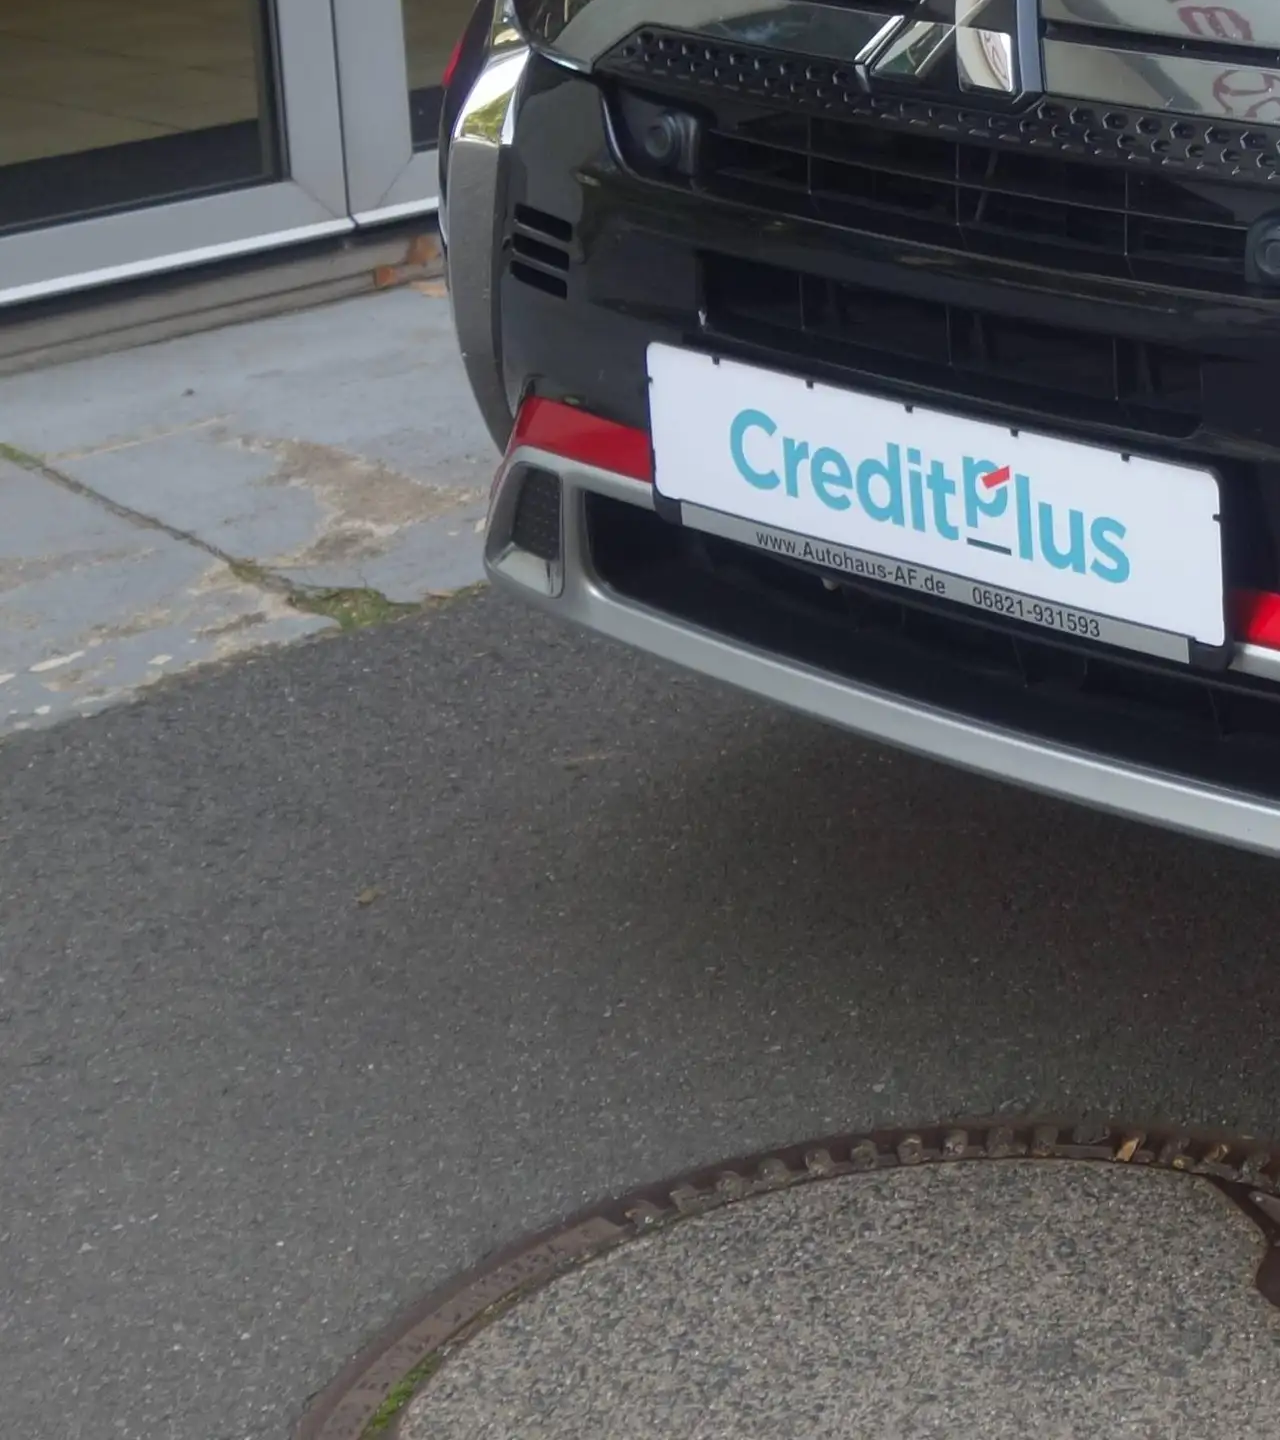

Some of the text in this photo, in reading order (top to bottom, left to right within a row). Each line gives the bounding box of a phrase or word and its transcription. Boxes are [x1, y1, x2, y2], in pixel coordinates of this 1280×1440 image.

[729, 408, 1131, 585] CreditPlus
[755, 530, 1101, 638] www.Autohaus-AF.de 06821-931593
